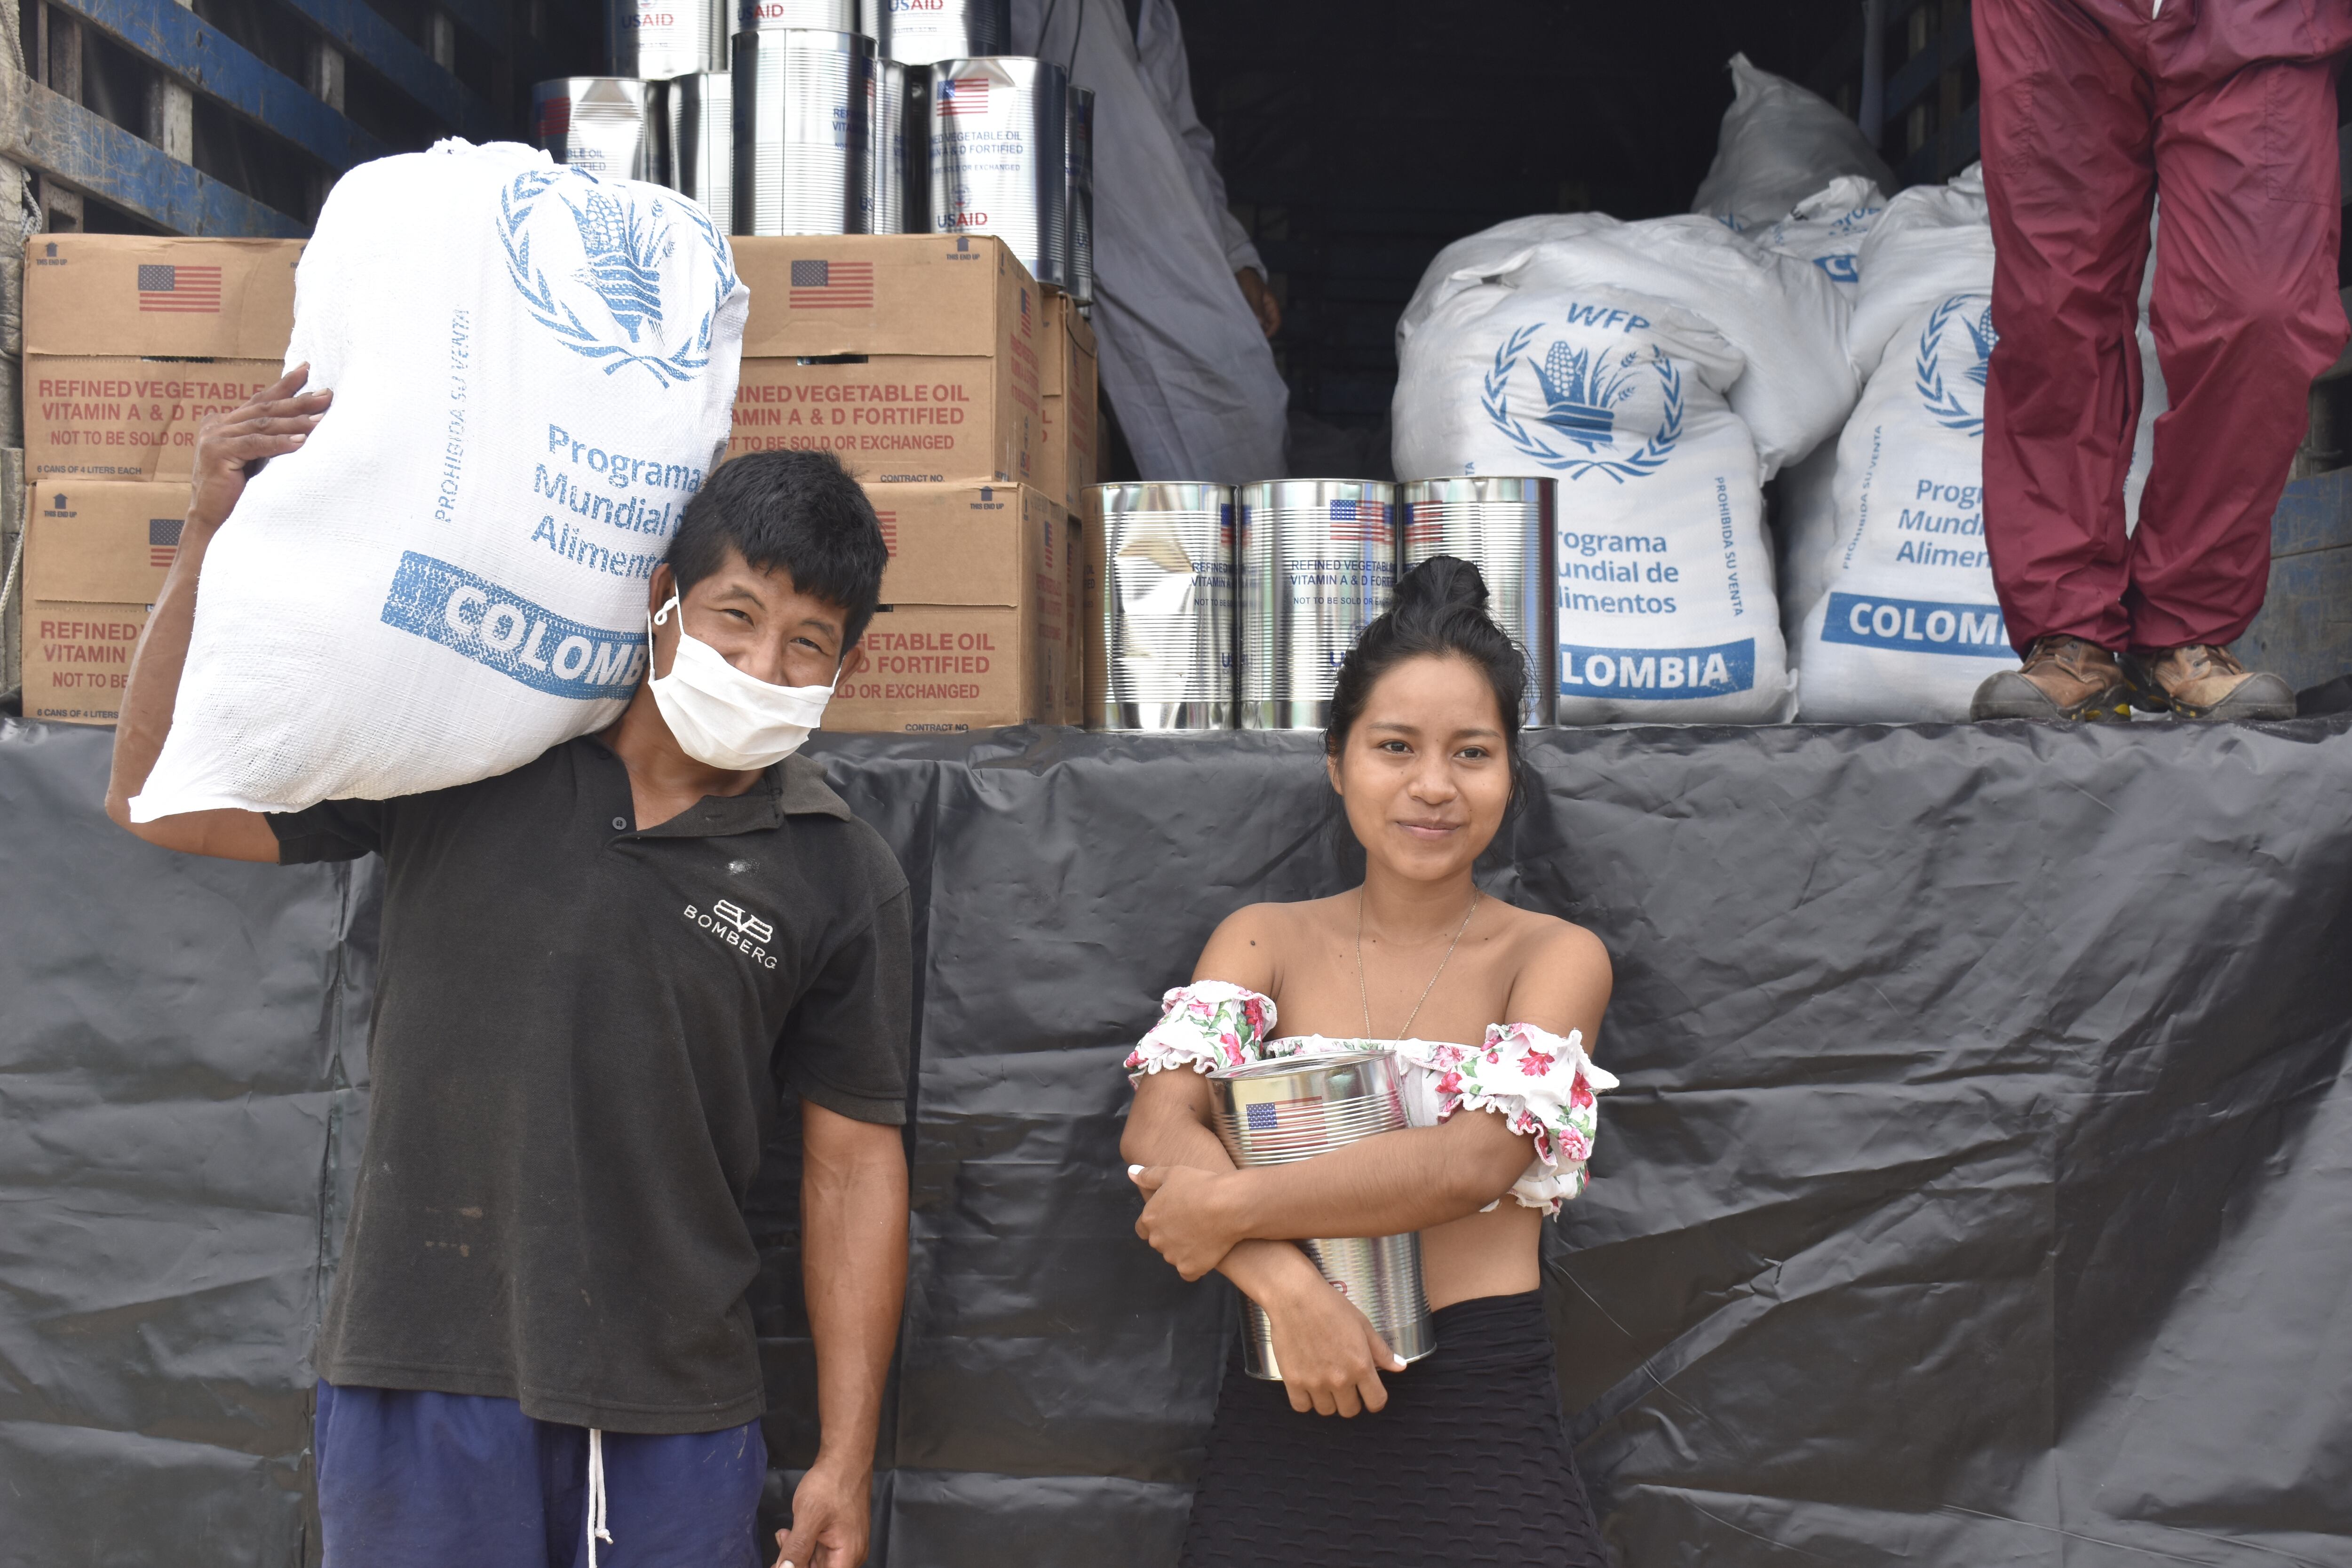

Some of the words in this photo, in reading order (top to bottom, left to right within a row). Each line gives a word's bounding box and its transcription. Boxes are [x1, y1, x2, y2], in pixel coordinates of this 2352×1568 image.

[621, 14, 674, 29] USAID
[738, 5, 784, 22] USAID
[1006, 131, 1023, 141] OIL
[969, 144, 1024, 155] FORTIFIED
[938, 212, 988, 228] USAID
[1566, 302, 1651, 333] WFP
[39, 380, 132, 398] REFINED
[739, 385, 792, 403] INED
[795, 385, 928, 403] VEGETABLE
[932, 384, 969, 402] OIL
[42, 403, 120, 420] VITAMIN
[127, 404, 141, 421] A
[150, 404, 164, 421] &
[172, 405, 184, 421] D
[434, 408, 466, 524] PROHIBIDA
[451, 307, 469, 369] VENTA
[732, 408, 781, 426] AMIN
[788, 408, 803, 425] A
[810, 408, 825, 426] &
[832, 408, 846, 425] D
[853, 407, 964, 425] FORTIFIED
[51, 430, 80, 446] NOT
[83, 431, 102, 446] TO
[106, 431, 125, 446] BE
[129, 431, 169, 446] SOLD
[173, 432, 194, 446] OR
[742, 436, 762, 451] TO
[766, 436, 786, 450] BE
[790, 436, 831, 451] SOLD
[834, 435, 856, 450] OR
[860, 435, 954, 450] EXCHANGED
[549, 423, 701, 493] Programa
[44, 465, 66, 473] CANS
[880, 474, 928, 483] CONTRACT
[930, 474, 945, 483] NO.
[534, 462, 671, 537] Mundial
[1843, 493, 1867, 569] PROHIBIDA
[1863, 472, 1873, 489] SU
[1868, 425, 1882, 470] VENTA
[1715, 476, 1734, 549] PROHIBIDA
[531, 513, 667, 580] Aliment
[1558, 531, 1667, 557] ograma
[1725, 551, 1737, 569] SU
[1896, 541, 1992, 568] Alimen
[1192, 562, 1228, 573] REFINED
[1291, 560, 1340, 571] REFINED
[1344, 560, 1394, 573] VEGETABLE
[1558, 560, 1639, 582] undial
[1646, 561, 1679, 583] de
[1191, 576, 1225, 588] VITAMIN
[1290, 574, 1337, 585] VITAMIN
[1340, 575, 1348, 585] A
[1351, 575, 1358, 585] &
[1361, 575, 1368, 585] D
[1558, 586, 1677, 613] limentos
[1728, 572, 1744, 617] VENTA
[40, 621, 137, 641] REFINED
[1849, 603, 2010, 646] COLOM
[445, 584, 649, 686] COLOMB
[860, 633, 954, 651] ETABLE
[958, 633, 995, 651] OIL
[44, 644, 126, 663] VITAMIN
[878, 656, 990, 674] FORTIFIED
[1562, 652, 1729, 688] LOMBIA
[53, 671, 83, 688] NOT
[87, 673, 106, 688] TO
[111, 674, 129, 688] BE
[833, 685, 855, 699] LD
[859, 684, 881, 699] OR
[886, 684, 979, 699] EXCHANGED
[44, 708, 67, 717] CANS
[683, 904, 777, 969] BOMBERG
